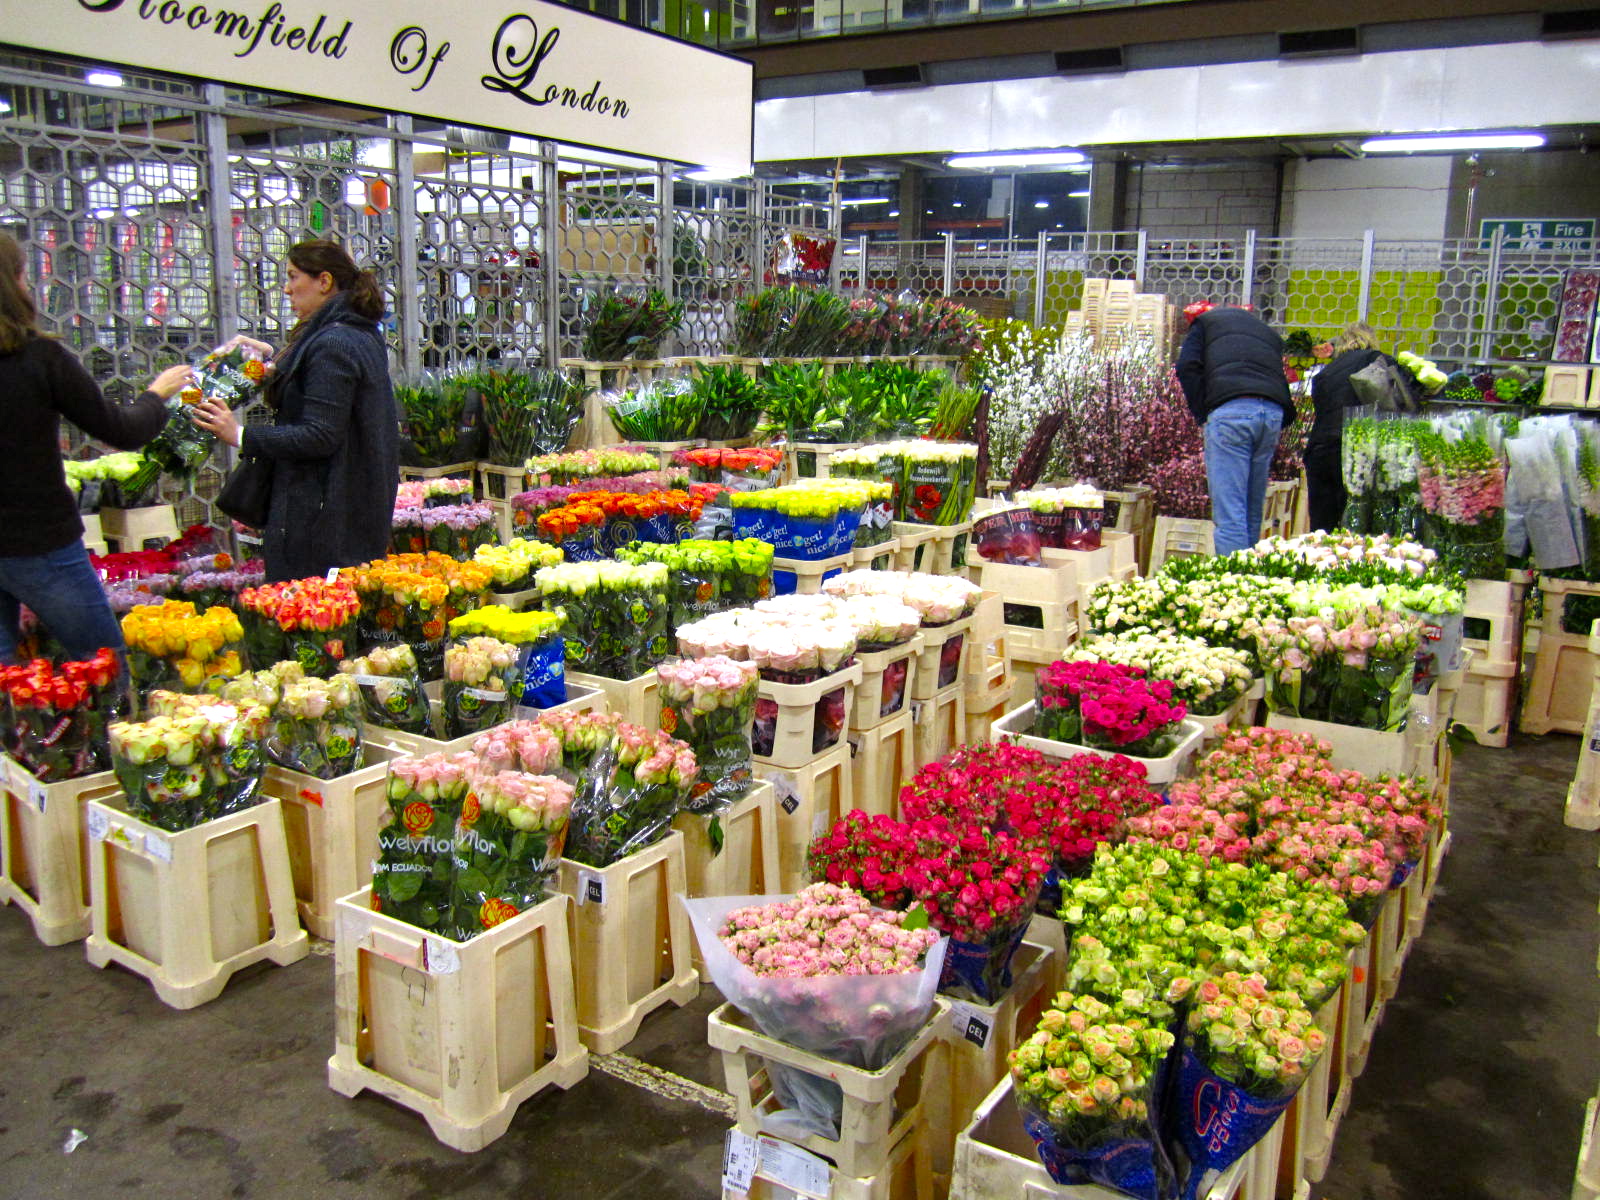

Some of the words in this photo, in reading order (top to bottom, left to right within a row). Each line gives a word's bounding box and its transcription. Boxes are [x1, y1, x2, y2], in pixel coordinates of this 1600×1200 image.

[78, 0, 353, 59] loomfield
[390, 26, 450, 92] Of
[481, 13, 630, 119] London
[1554, 223, 1585, 236] Fire
[775, 538, 793, 549] nice
[804, 530, 823, 546] get!
[526, 672, 552, 691] nice
[784, 798, 795, 811] CEL
[391, 863, 433, 873] ECUADOR
[968, 1024, 984, 1041] CEL
